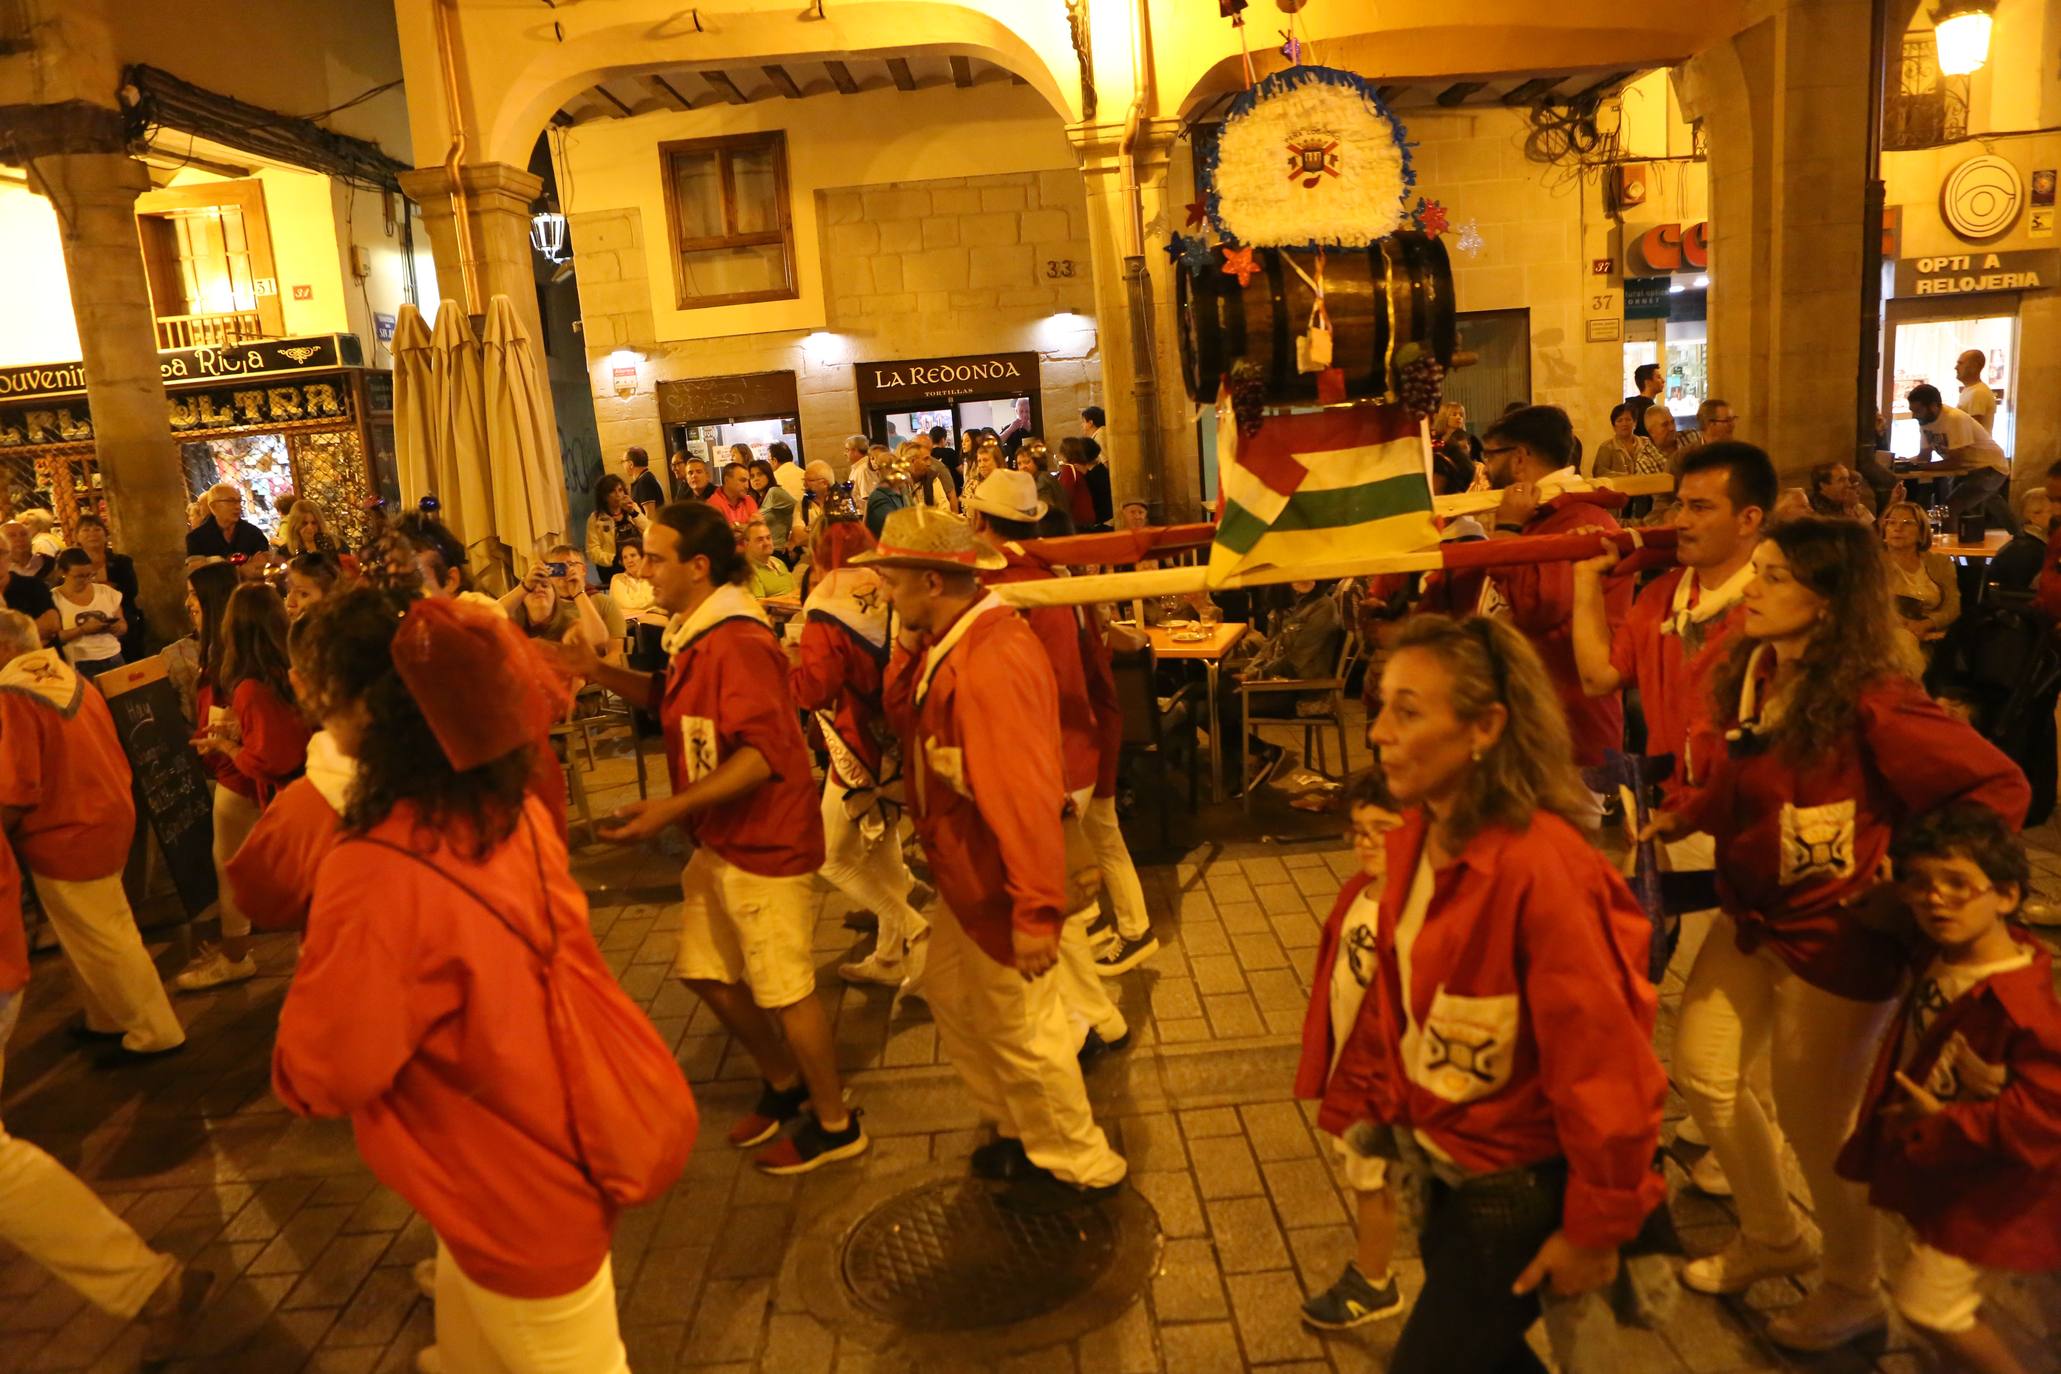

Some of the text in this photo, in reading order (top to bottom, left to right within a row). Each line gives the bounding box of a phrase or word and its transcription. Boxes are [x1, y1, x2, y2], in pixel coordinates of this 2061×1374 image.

[1046, 259, 1073, 279] 33
[1595, 261, 1611, 273] 37
[1917, 254, 2001, 273] OPTI A
[1916, 271, 2041, 295] RELOJERIA
[1592, 295, 1614, 311] 37
[0, 364, 86, 393] ouvenir
[875, 361, 1021, 389] LA REDONDA
[924, 388, 974, 398] TORTILLAS
